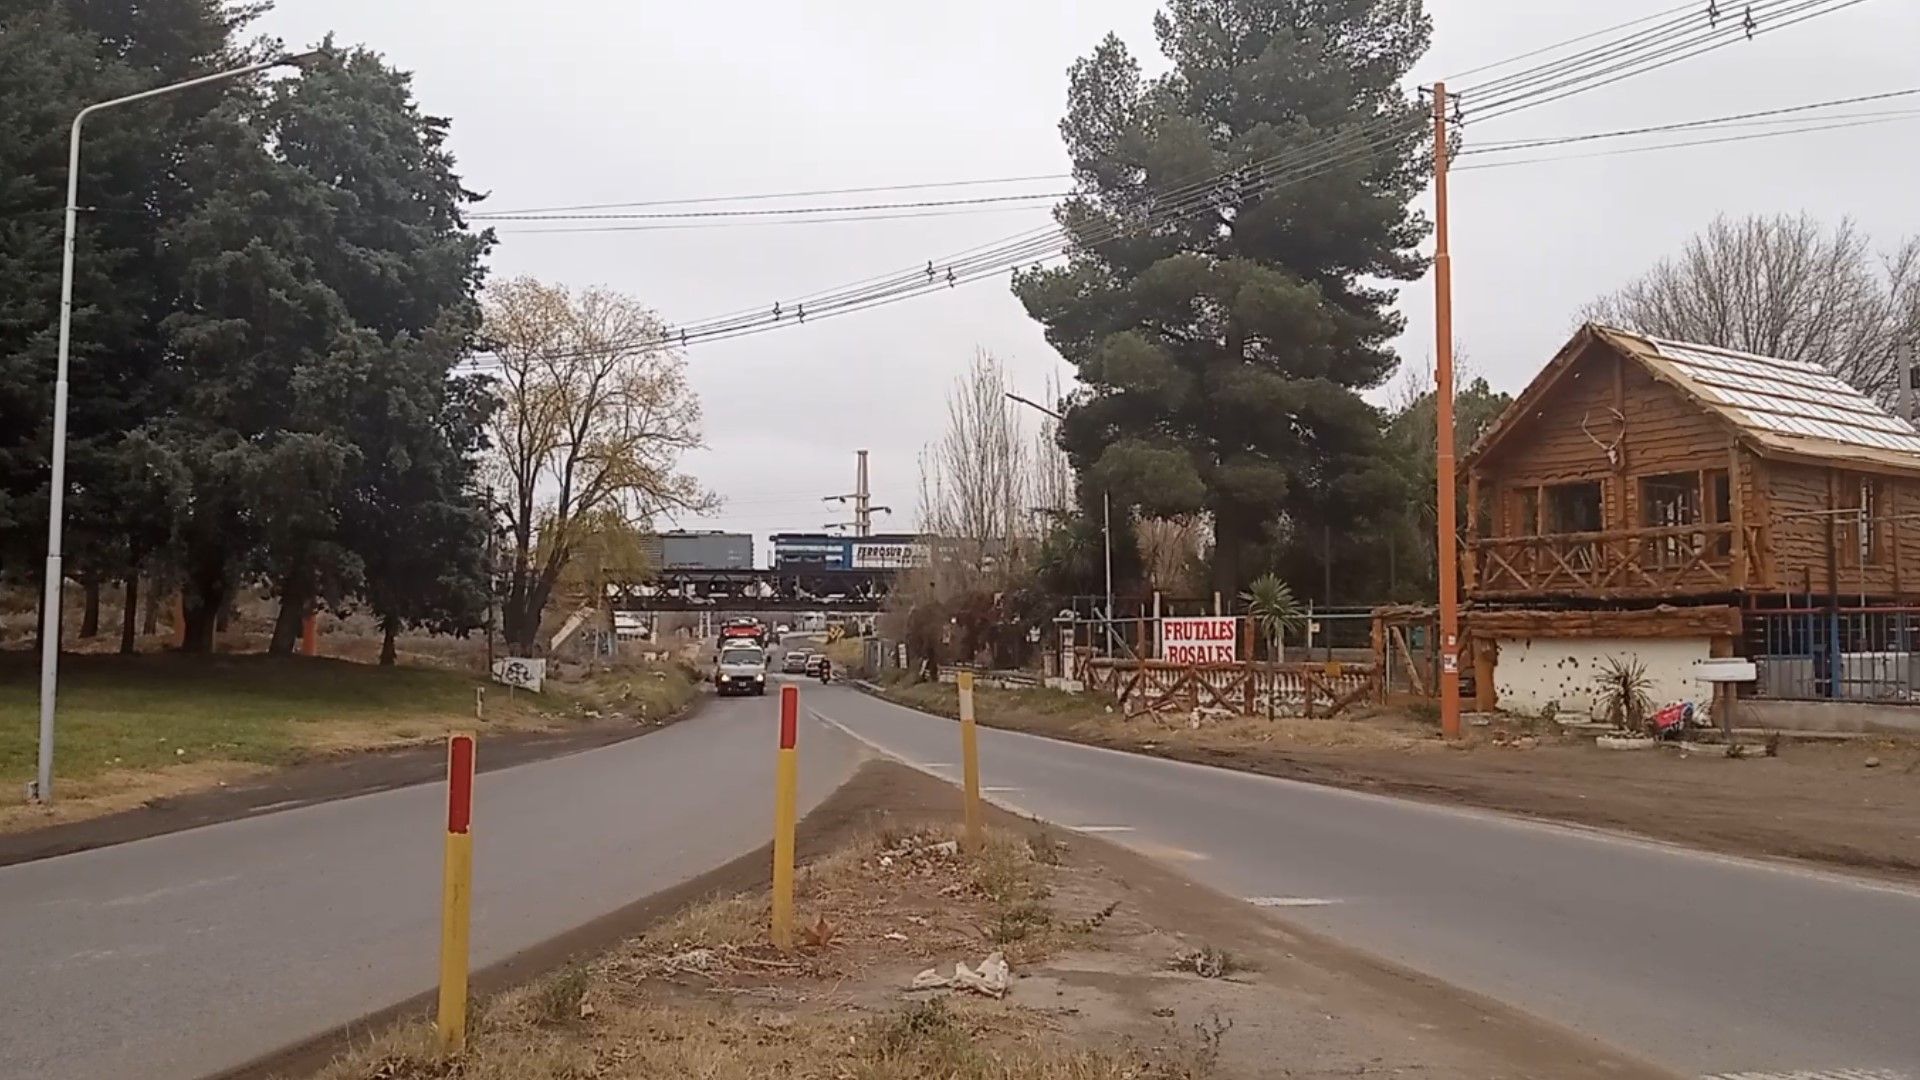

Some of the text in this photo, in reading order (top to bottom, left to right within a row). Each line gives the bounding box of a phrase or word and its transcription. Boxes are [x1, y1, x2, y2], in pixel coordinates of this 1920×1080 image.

[857, 546, 902, 557] FERROSUR
[1164, 621, 1234, 641] FRUTALES
[1168, 645, 1233, 665] ROSALES
